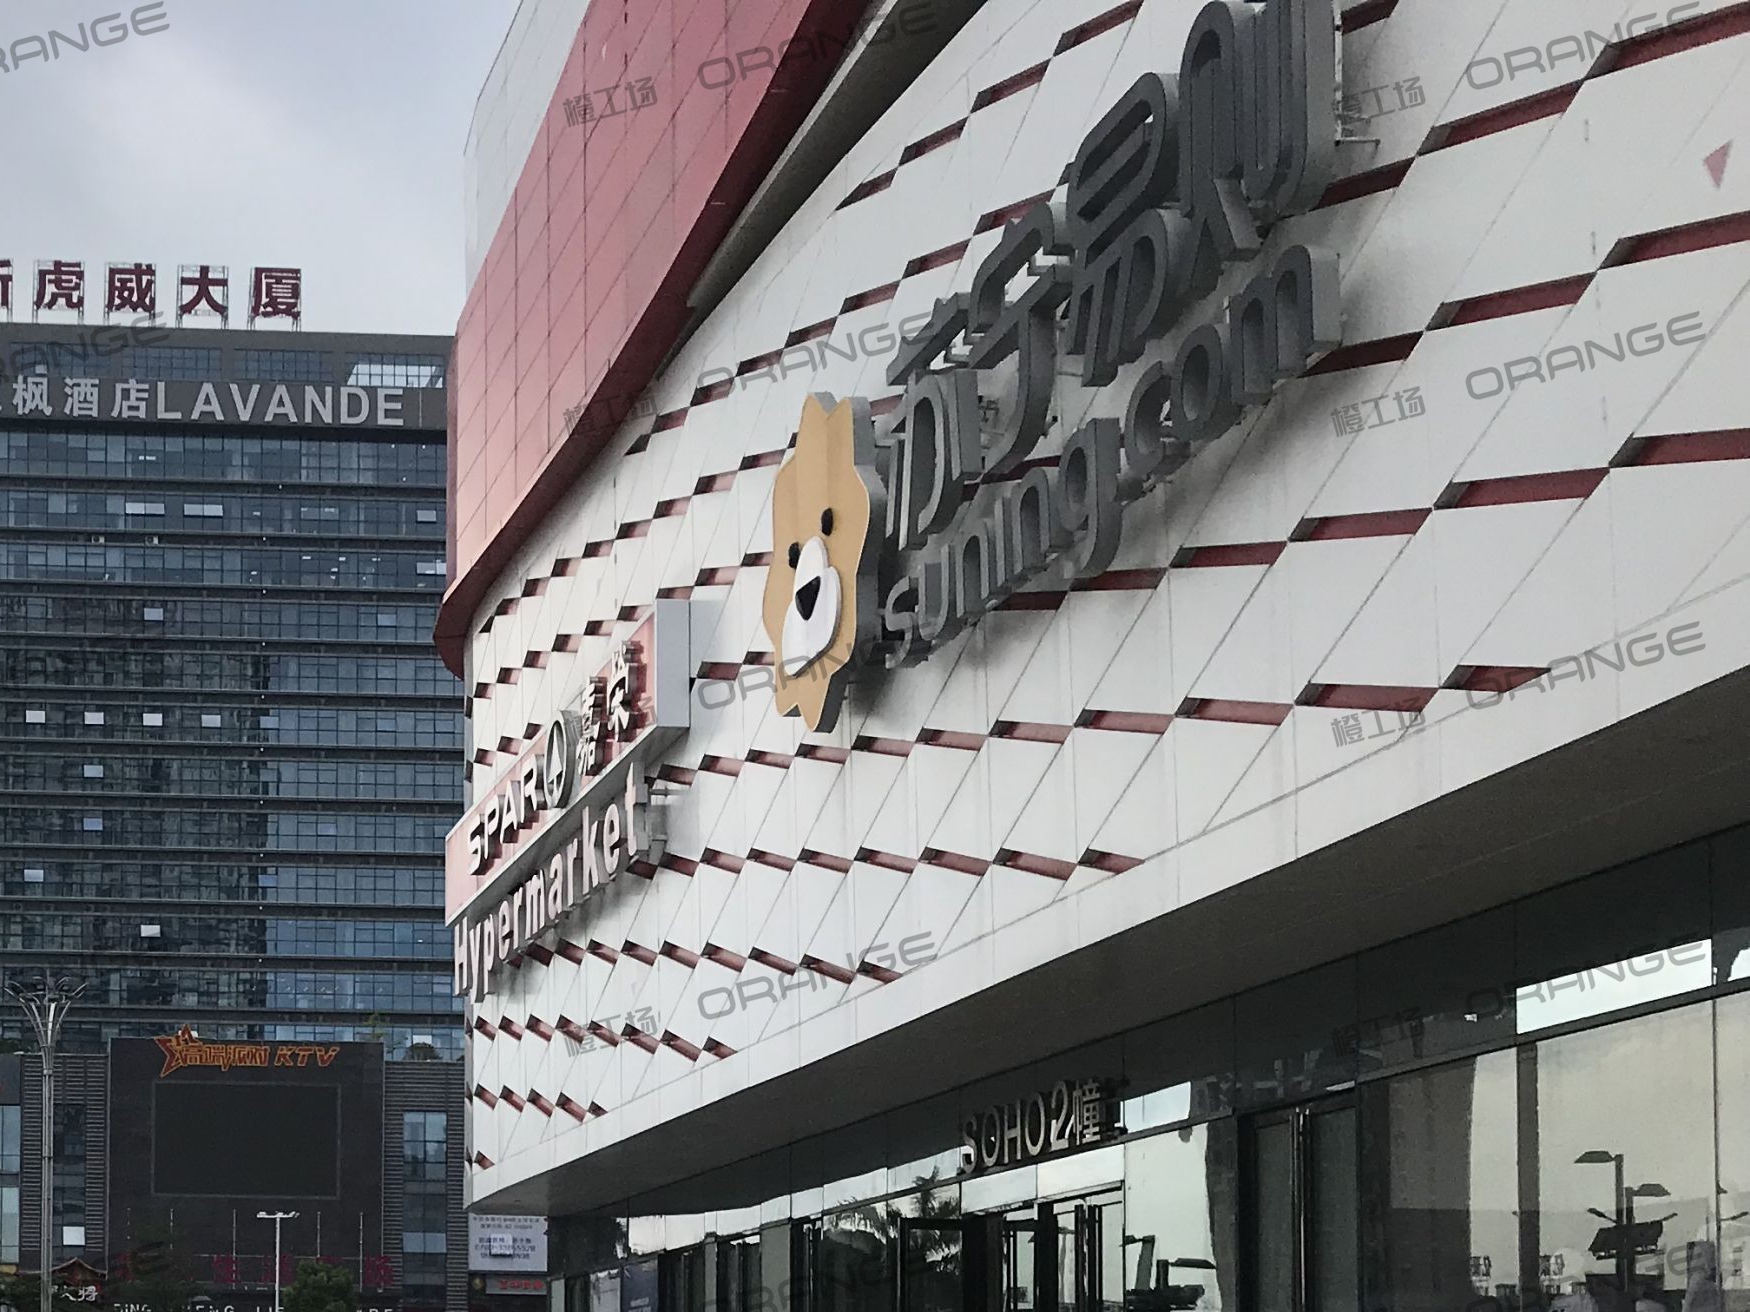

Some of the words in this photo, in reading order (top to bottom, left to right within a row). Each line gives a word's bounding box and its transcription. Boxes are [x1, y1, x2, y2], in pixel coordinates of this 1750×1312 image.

[466, 753, 541, 872] SPAR
[454, 761, 640, 1004] Hypermarket
[274, 1046, 340, 1067] KTV
